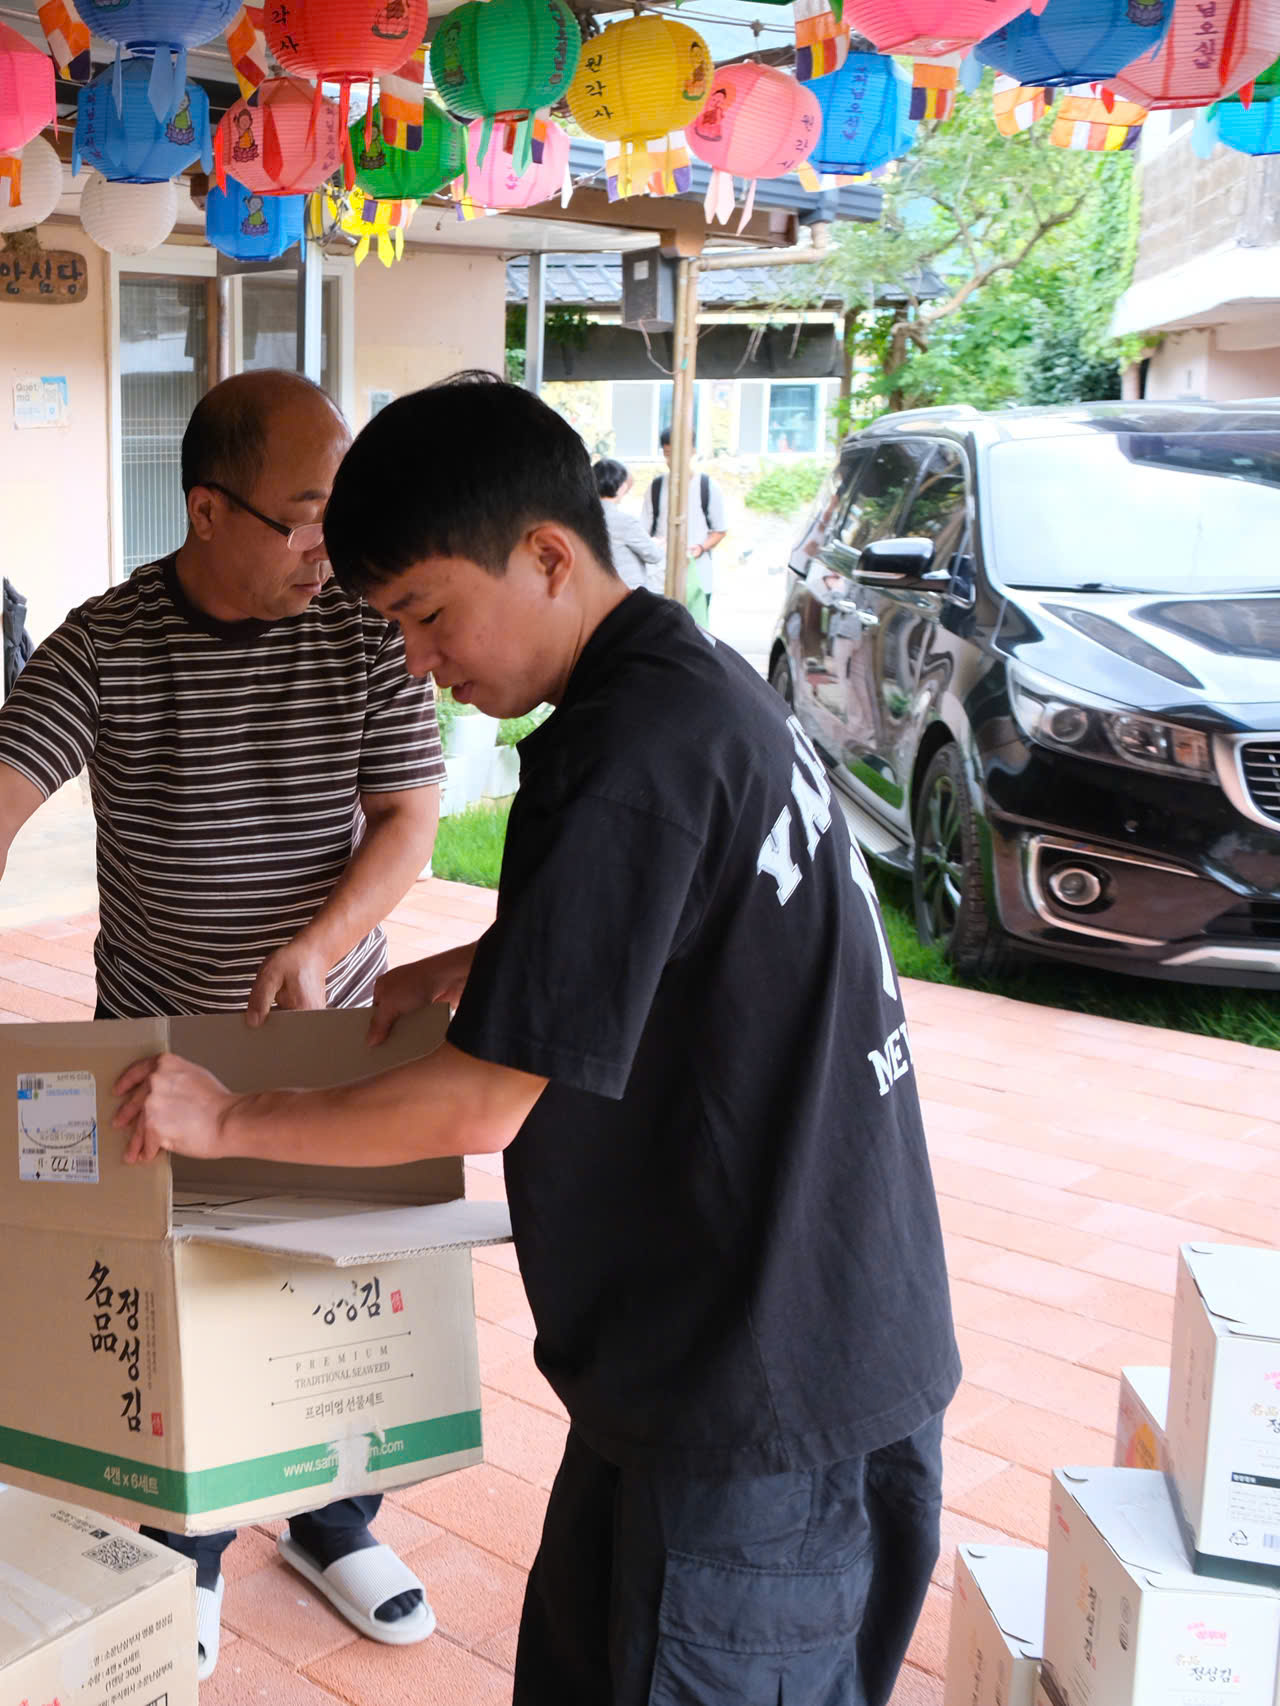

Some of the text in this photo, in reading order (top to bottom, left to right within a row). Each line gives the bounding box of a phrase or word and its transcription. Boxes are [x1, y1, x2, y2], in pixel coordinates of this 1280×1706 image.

[584, 54, 614, 120] 원각사
[0, 258, 83, 296] 안심당
[85, 1259, 119, 1353] 名品
[116, 1287, 142, 1433] 정성김
[294, 1361, 391, 1390] TRADITIONAL SEAWEED
[304, 1391, 385, 1420] 프리미엄 선물세트
[103, 1464, 121, 1486] 4캔
[130, 1472, 159, 1496] 6세트
